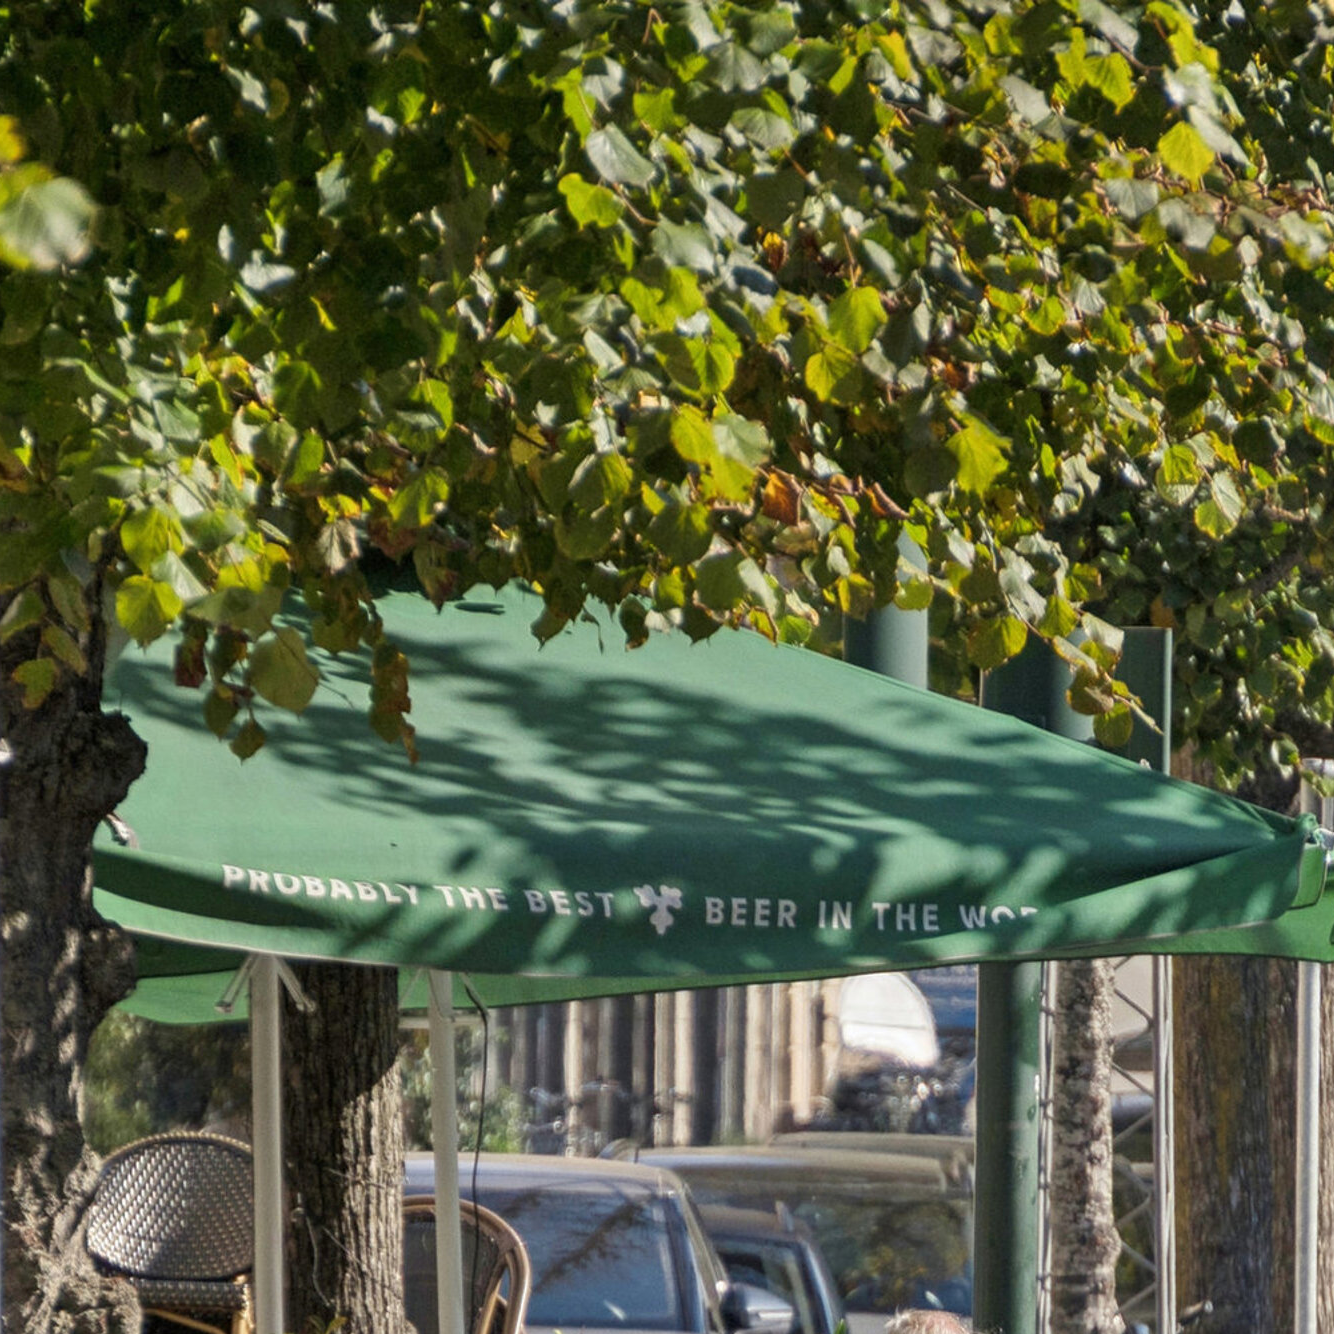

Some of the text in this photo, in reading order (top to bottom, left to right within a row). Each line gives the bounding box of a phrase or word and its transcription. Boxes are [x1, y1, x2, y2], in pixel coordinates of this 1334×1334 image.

[221, 864, 419, 905] PROBABLY
[433, 885, 509, 912] THE
[523, 889, 615, 918] BEST
[704, 896, 797, 928] BEER
[818, 900, 853, 929] IN
[871, 902, 941, 932] THE
